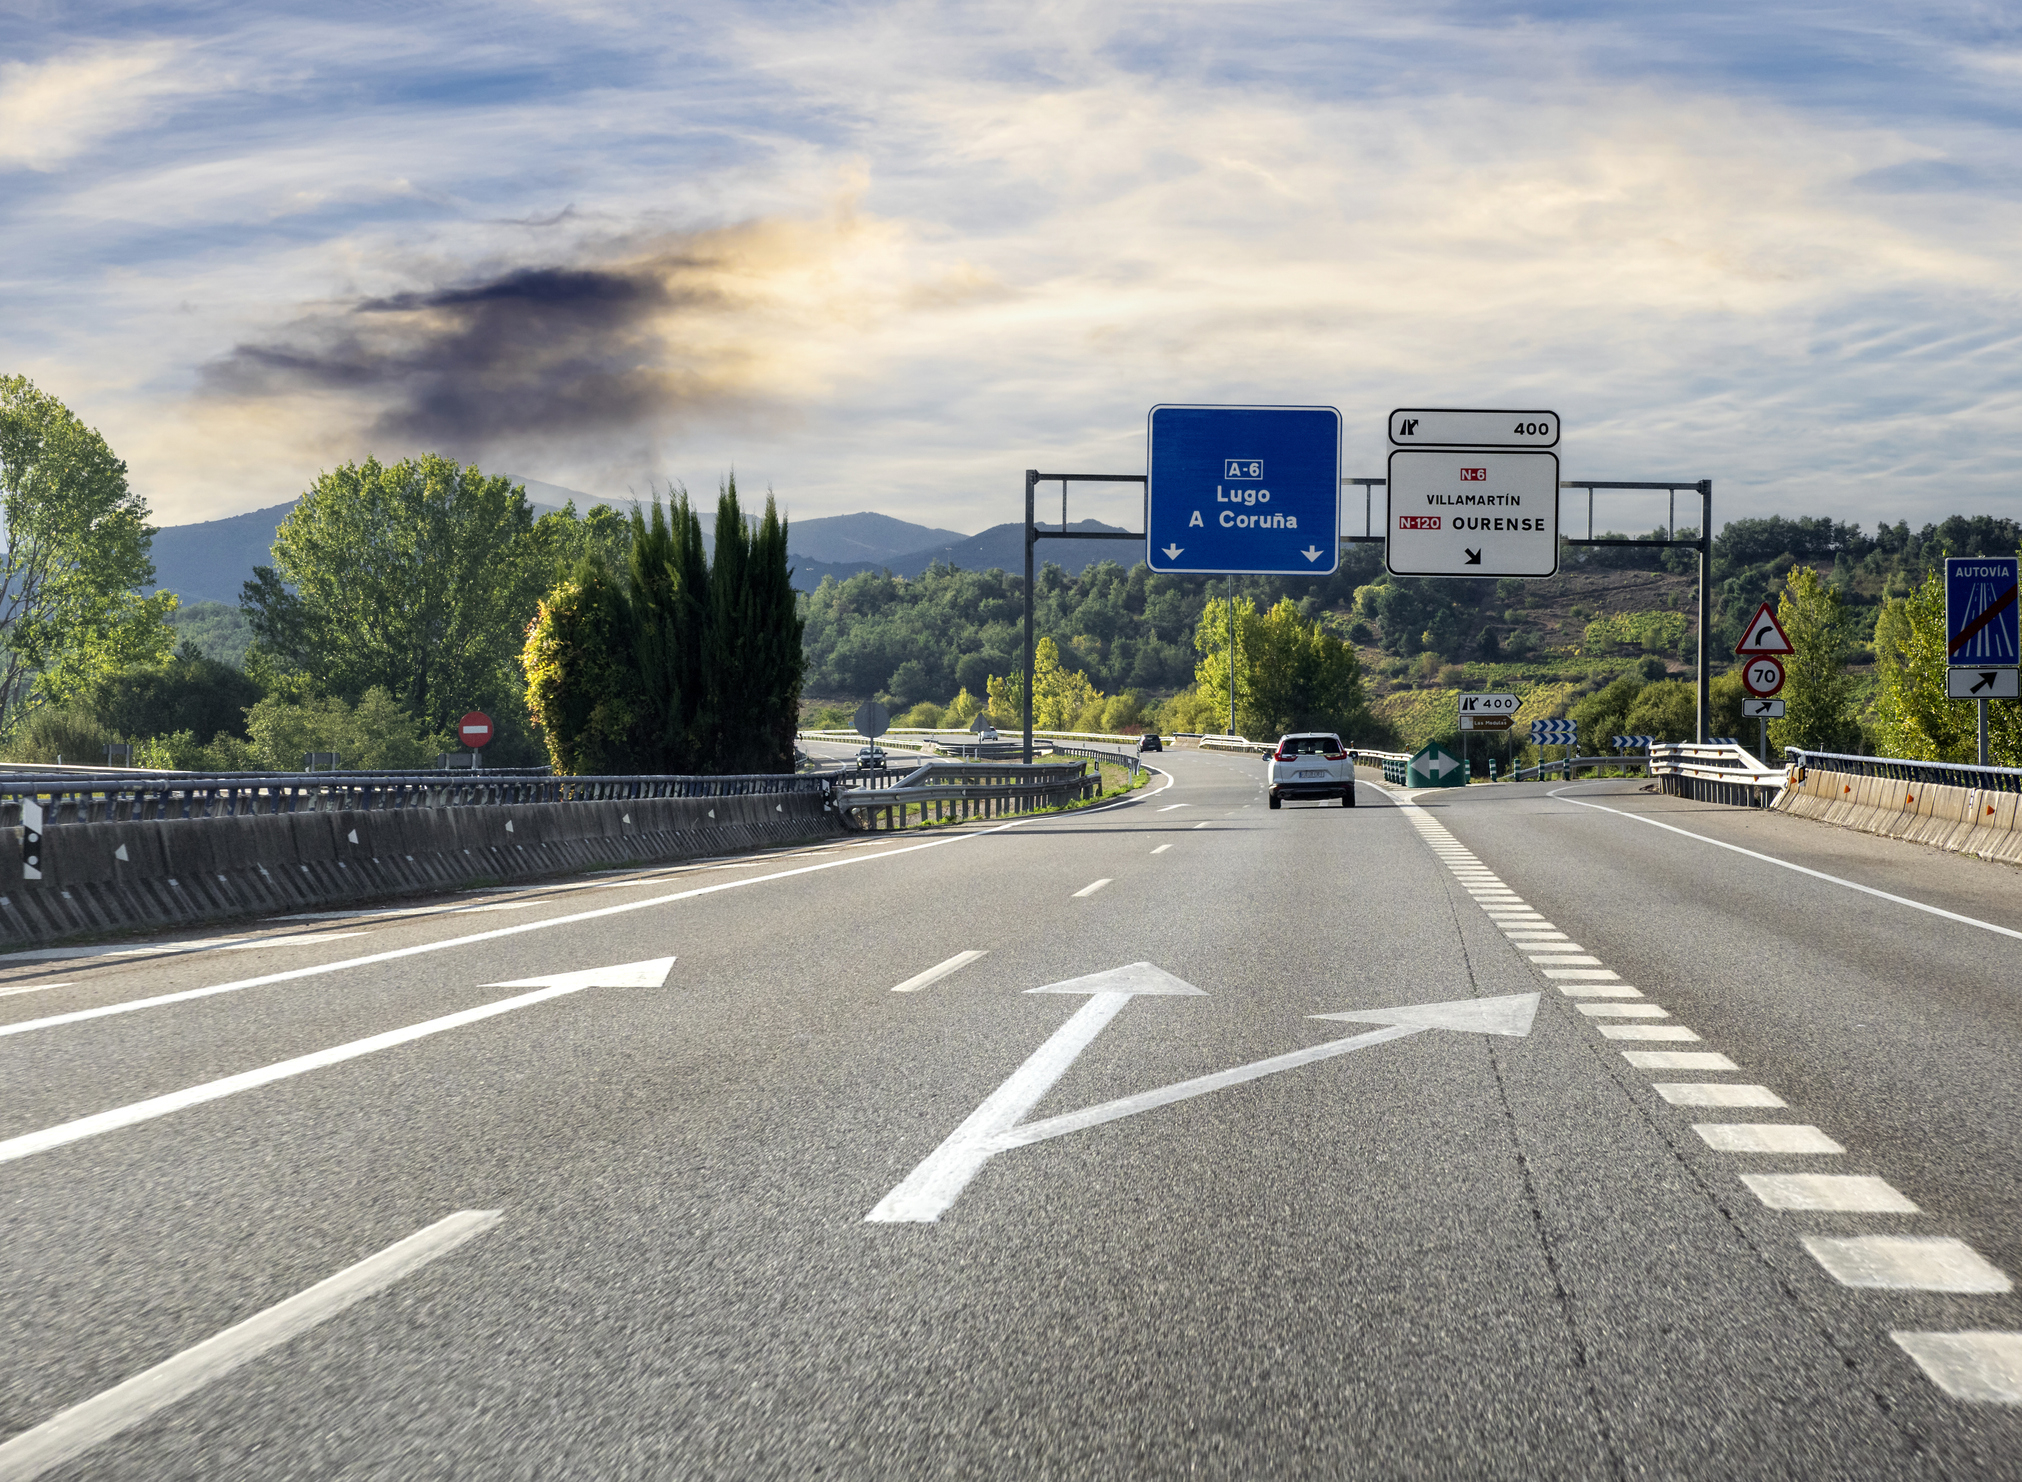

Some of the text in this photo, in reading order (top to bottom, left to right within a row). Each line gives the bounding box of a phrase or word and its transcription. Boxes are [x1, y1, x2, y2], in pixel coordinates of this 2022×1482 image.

[1513, 422, 1549, 436] 400
[1228, 462, 1260, 477] A-6
[1461, 469, 1485, 480] N-6
[1217, 485, 1271, 506] Lugo
[1426, 493, 1521, 506] VILLAMARTÍN
[1188, 510, 1298, 529] A Coruña
[1400, 517, 1545, 531] N-120 OURENSE
[1955, 564, 2010, 577] AUTOVÍA
[1754, 669, 1776, 683] 70
[1483, 699, 1512, 708] 400
